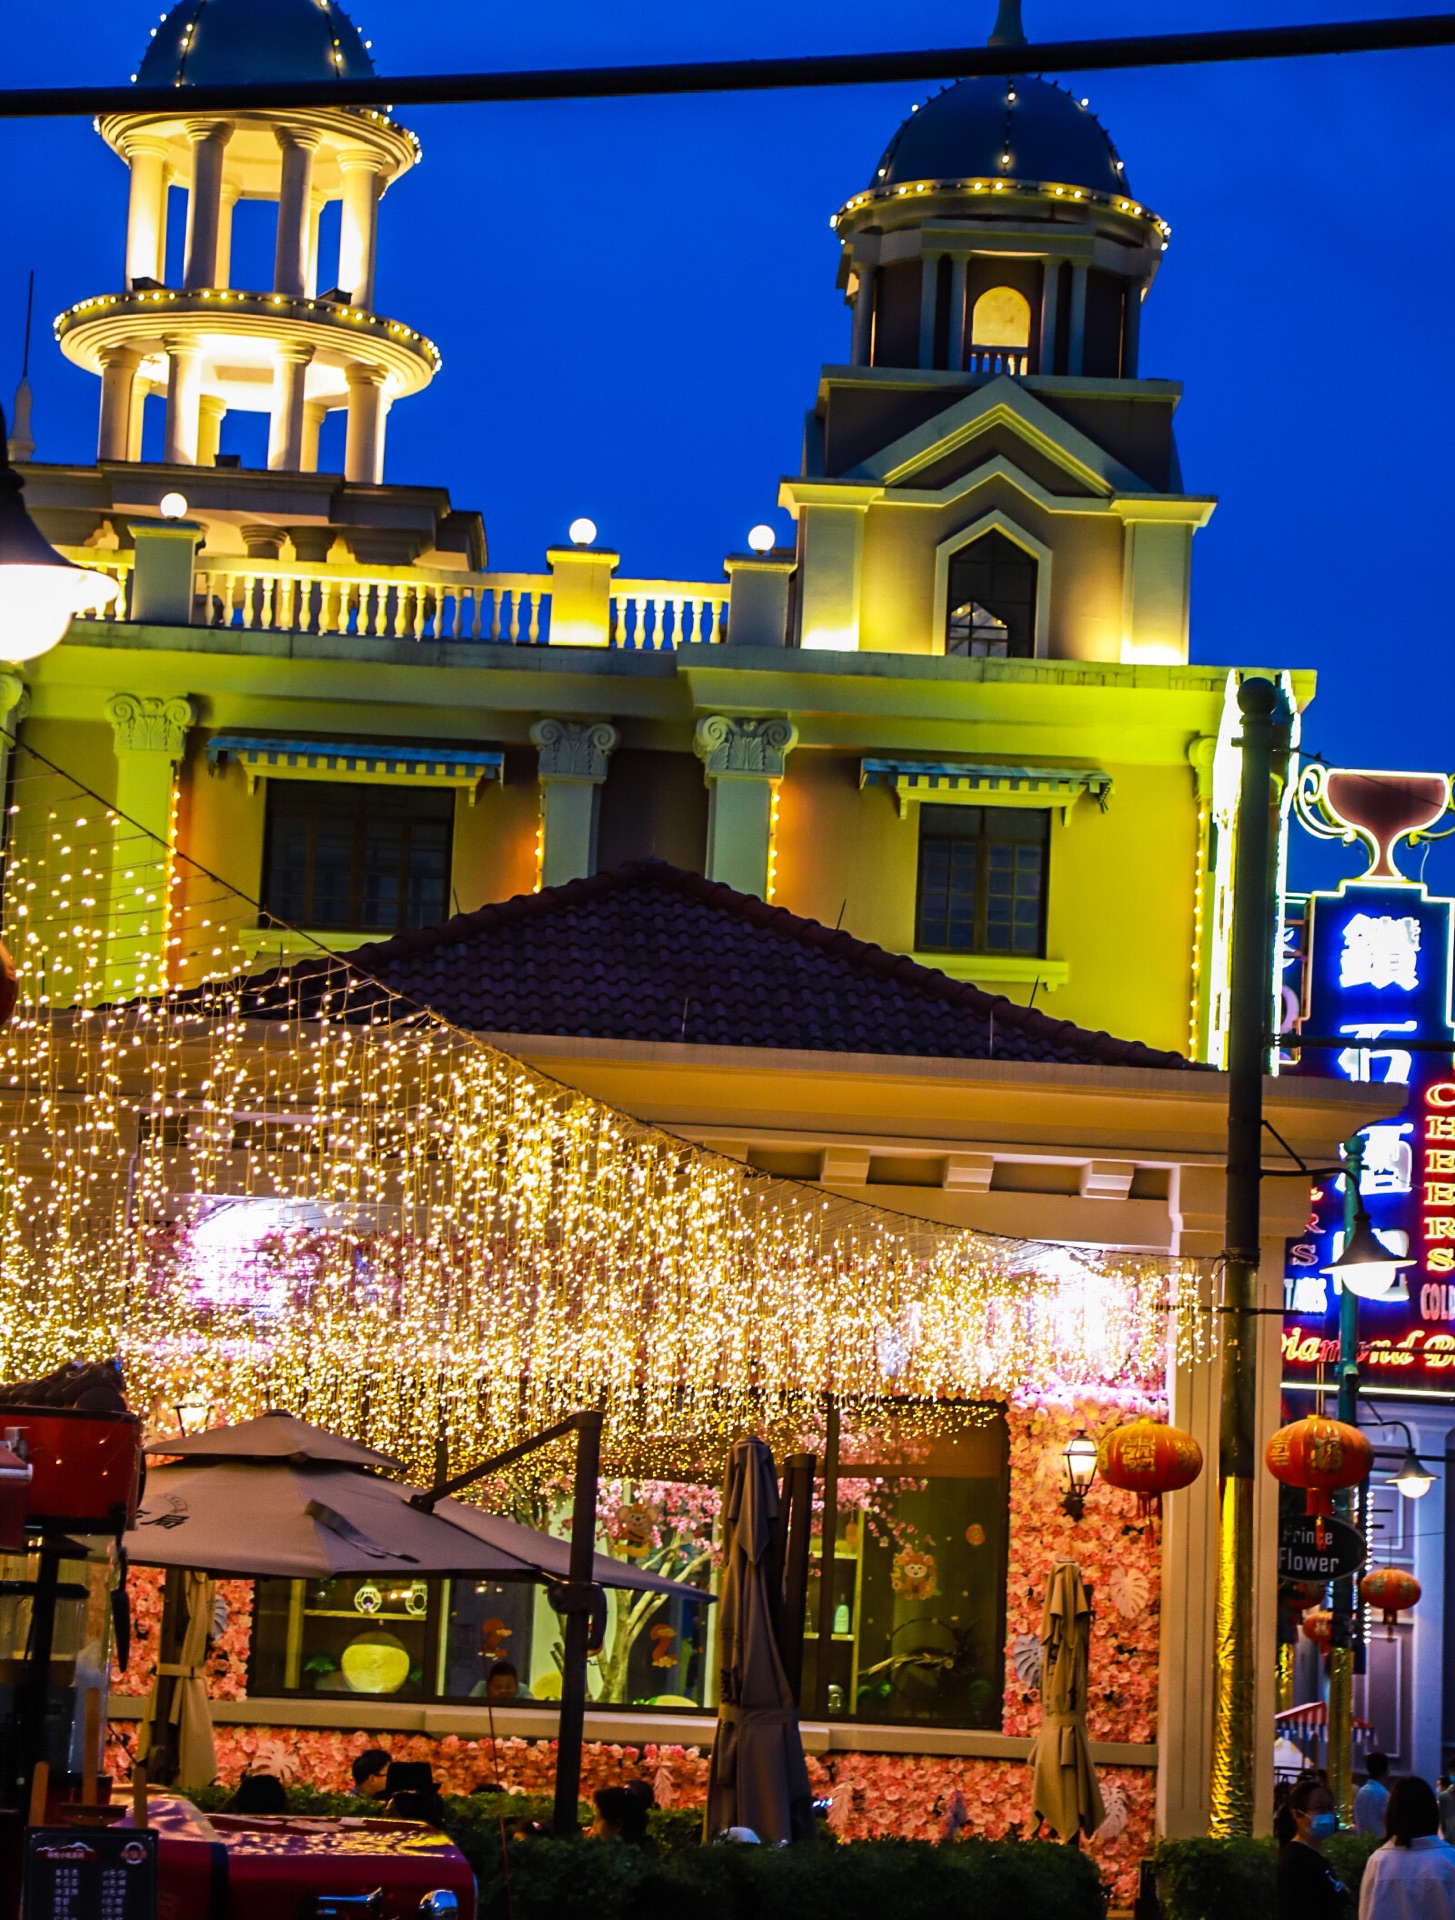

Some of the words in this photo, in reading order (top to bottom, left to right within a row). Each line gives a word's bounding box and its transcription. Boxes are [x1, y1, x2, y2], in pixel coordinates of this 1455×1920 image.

[1424, 1083, 1455, 1272] CHEERS
[1281, 1327, 1425, 1365] iamnd
[1283, 1524, 1333, 1545] rine
[1279, 1547, 1340, 1573] Flower
